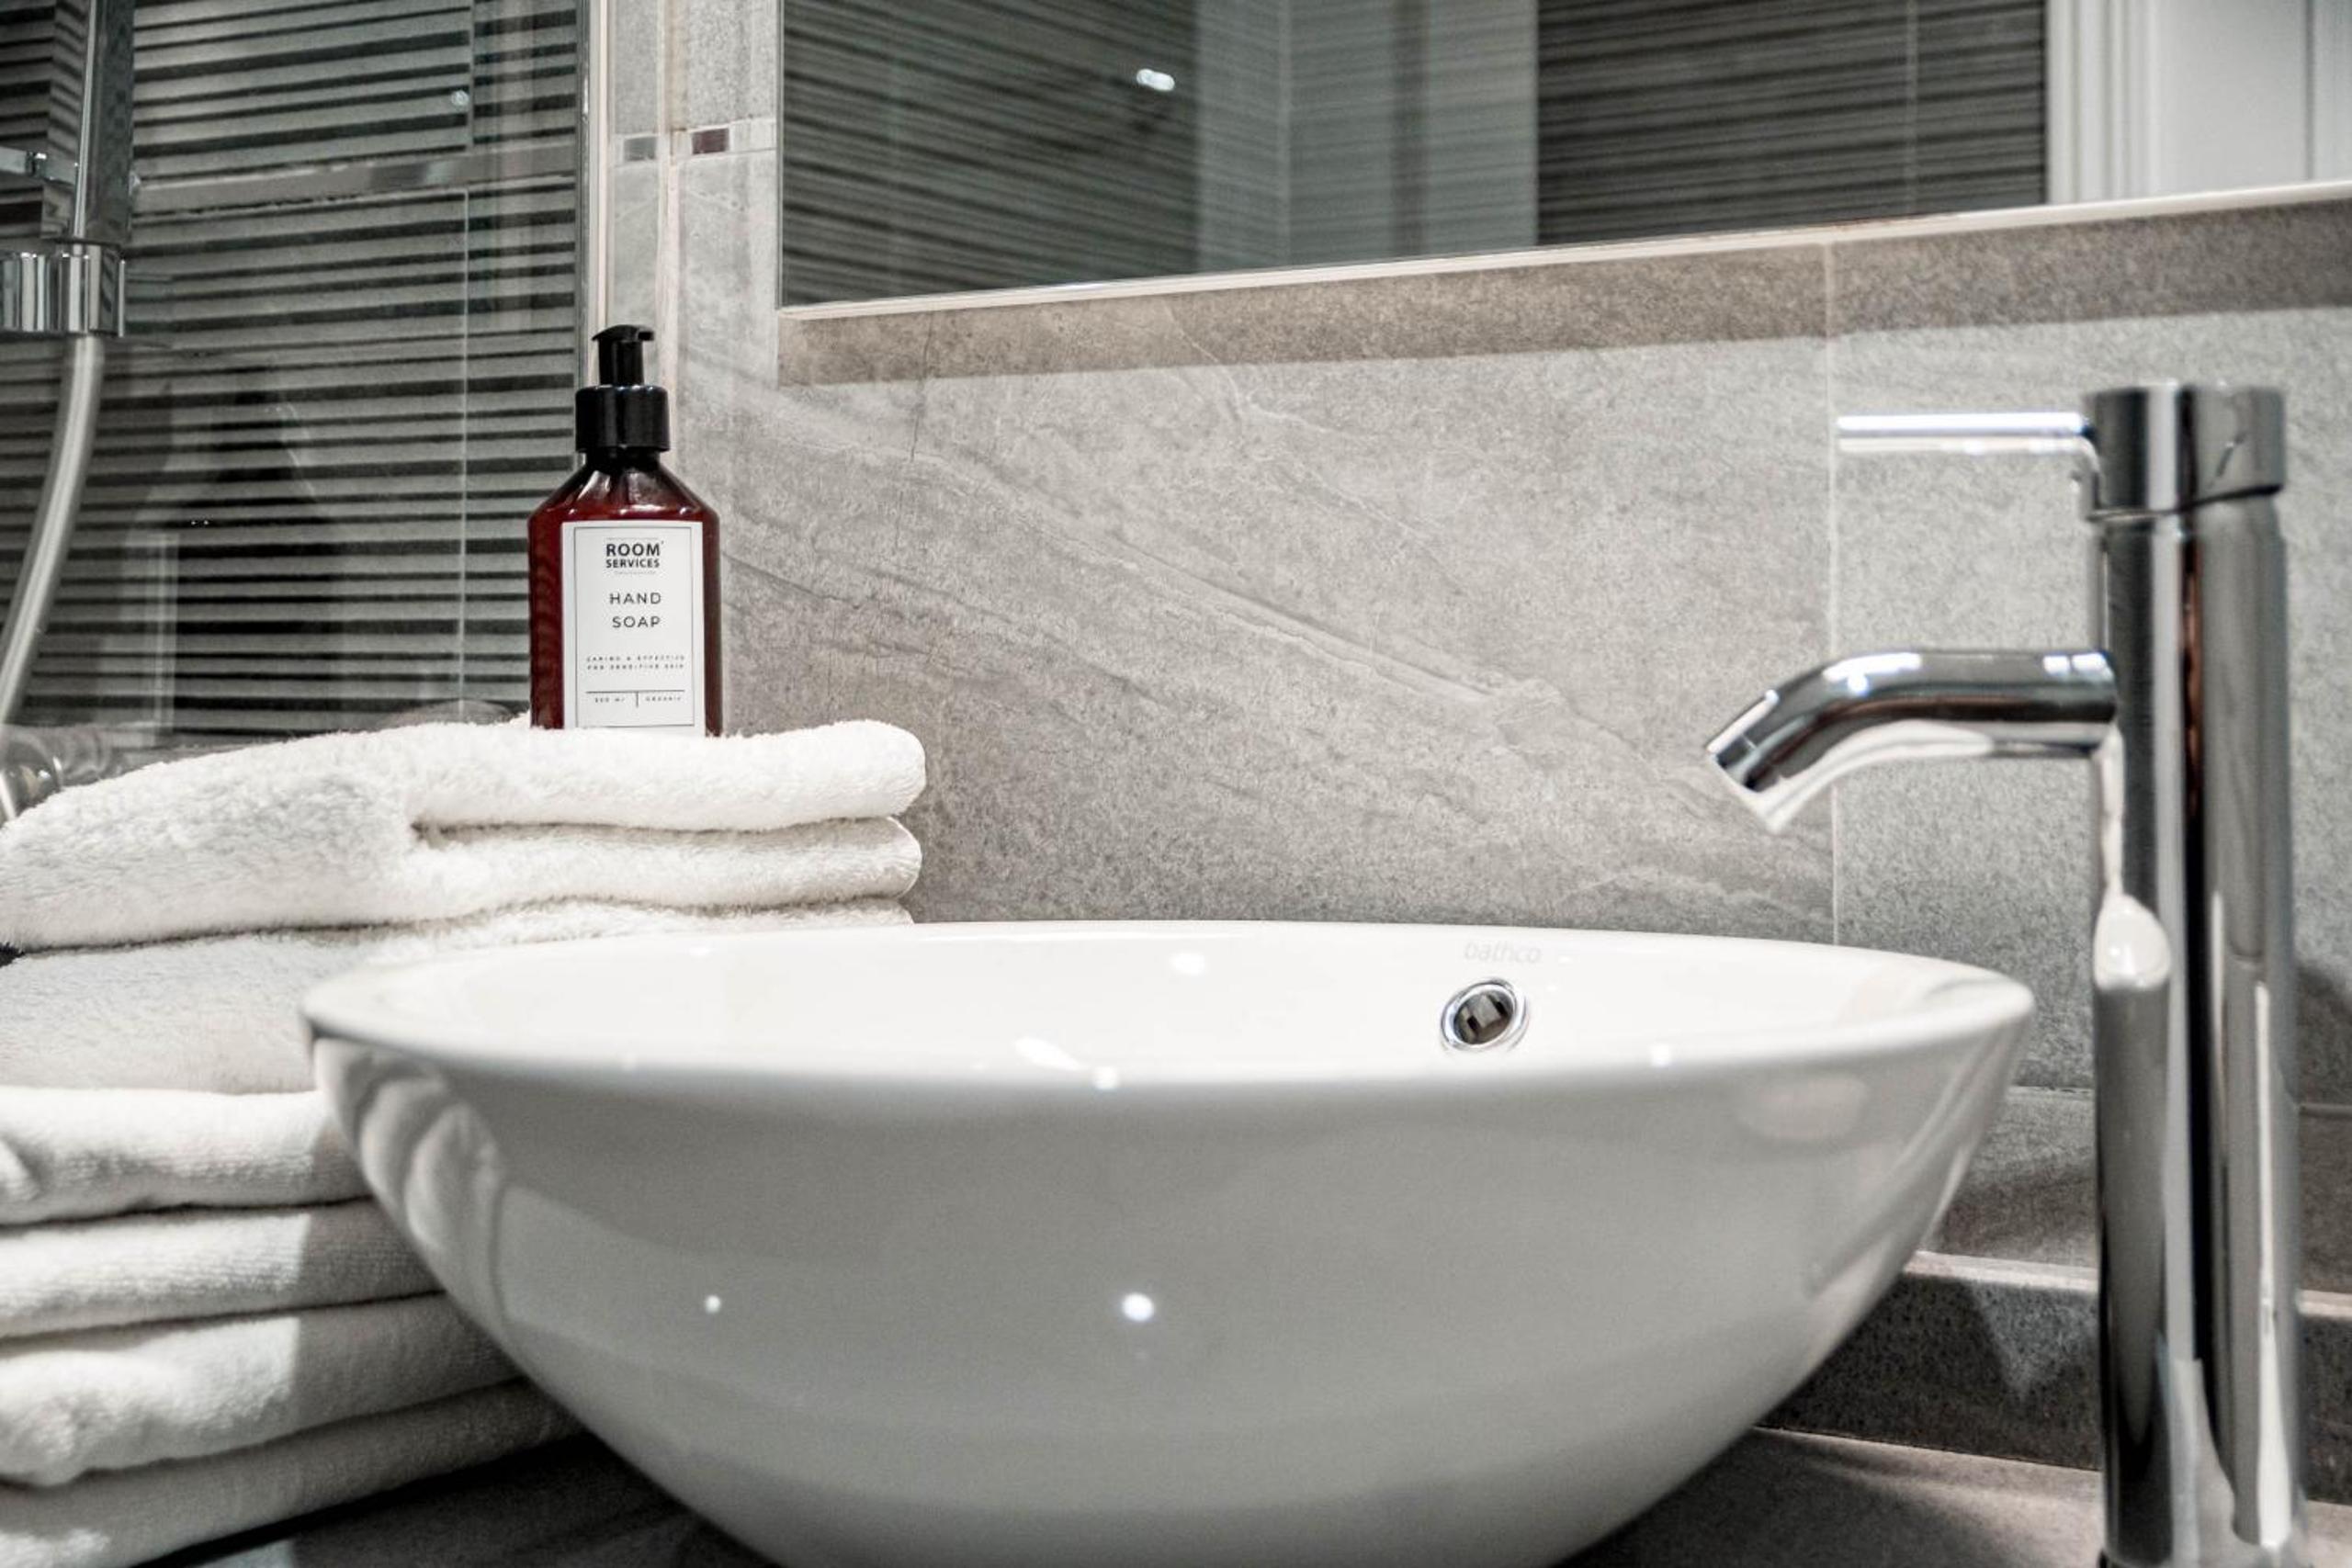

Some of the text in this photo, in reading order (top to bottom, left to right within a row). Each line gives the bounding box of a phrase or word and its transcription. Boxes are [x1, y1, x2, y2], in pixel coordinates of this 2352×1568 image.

[605, 543, 661, 557] ROOM
[605, 558, 661, 569] SERVICES
[609, 592, 662, 604] HAND
[612, 615, 661, 628] SOAP
